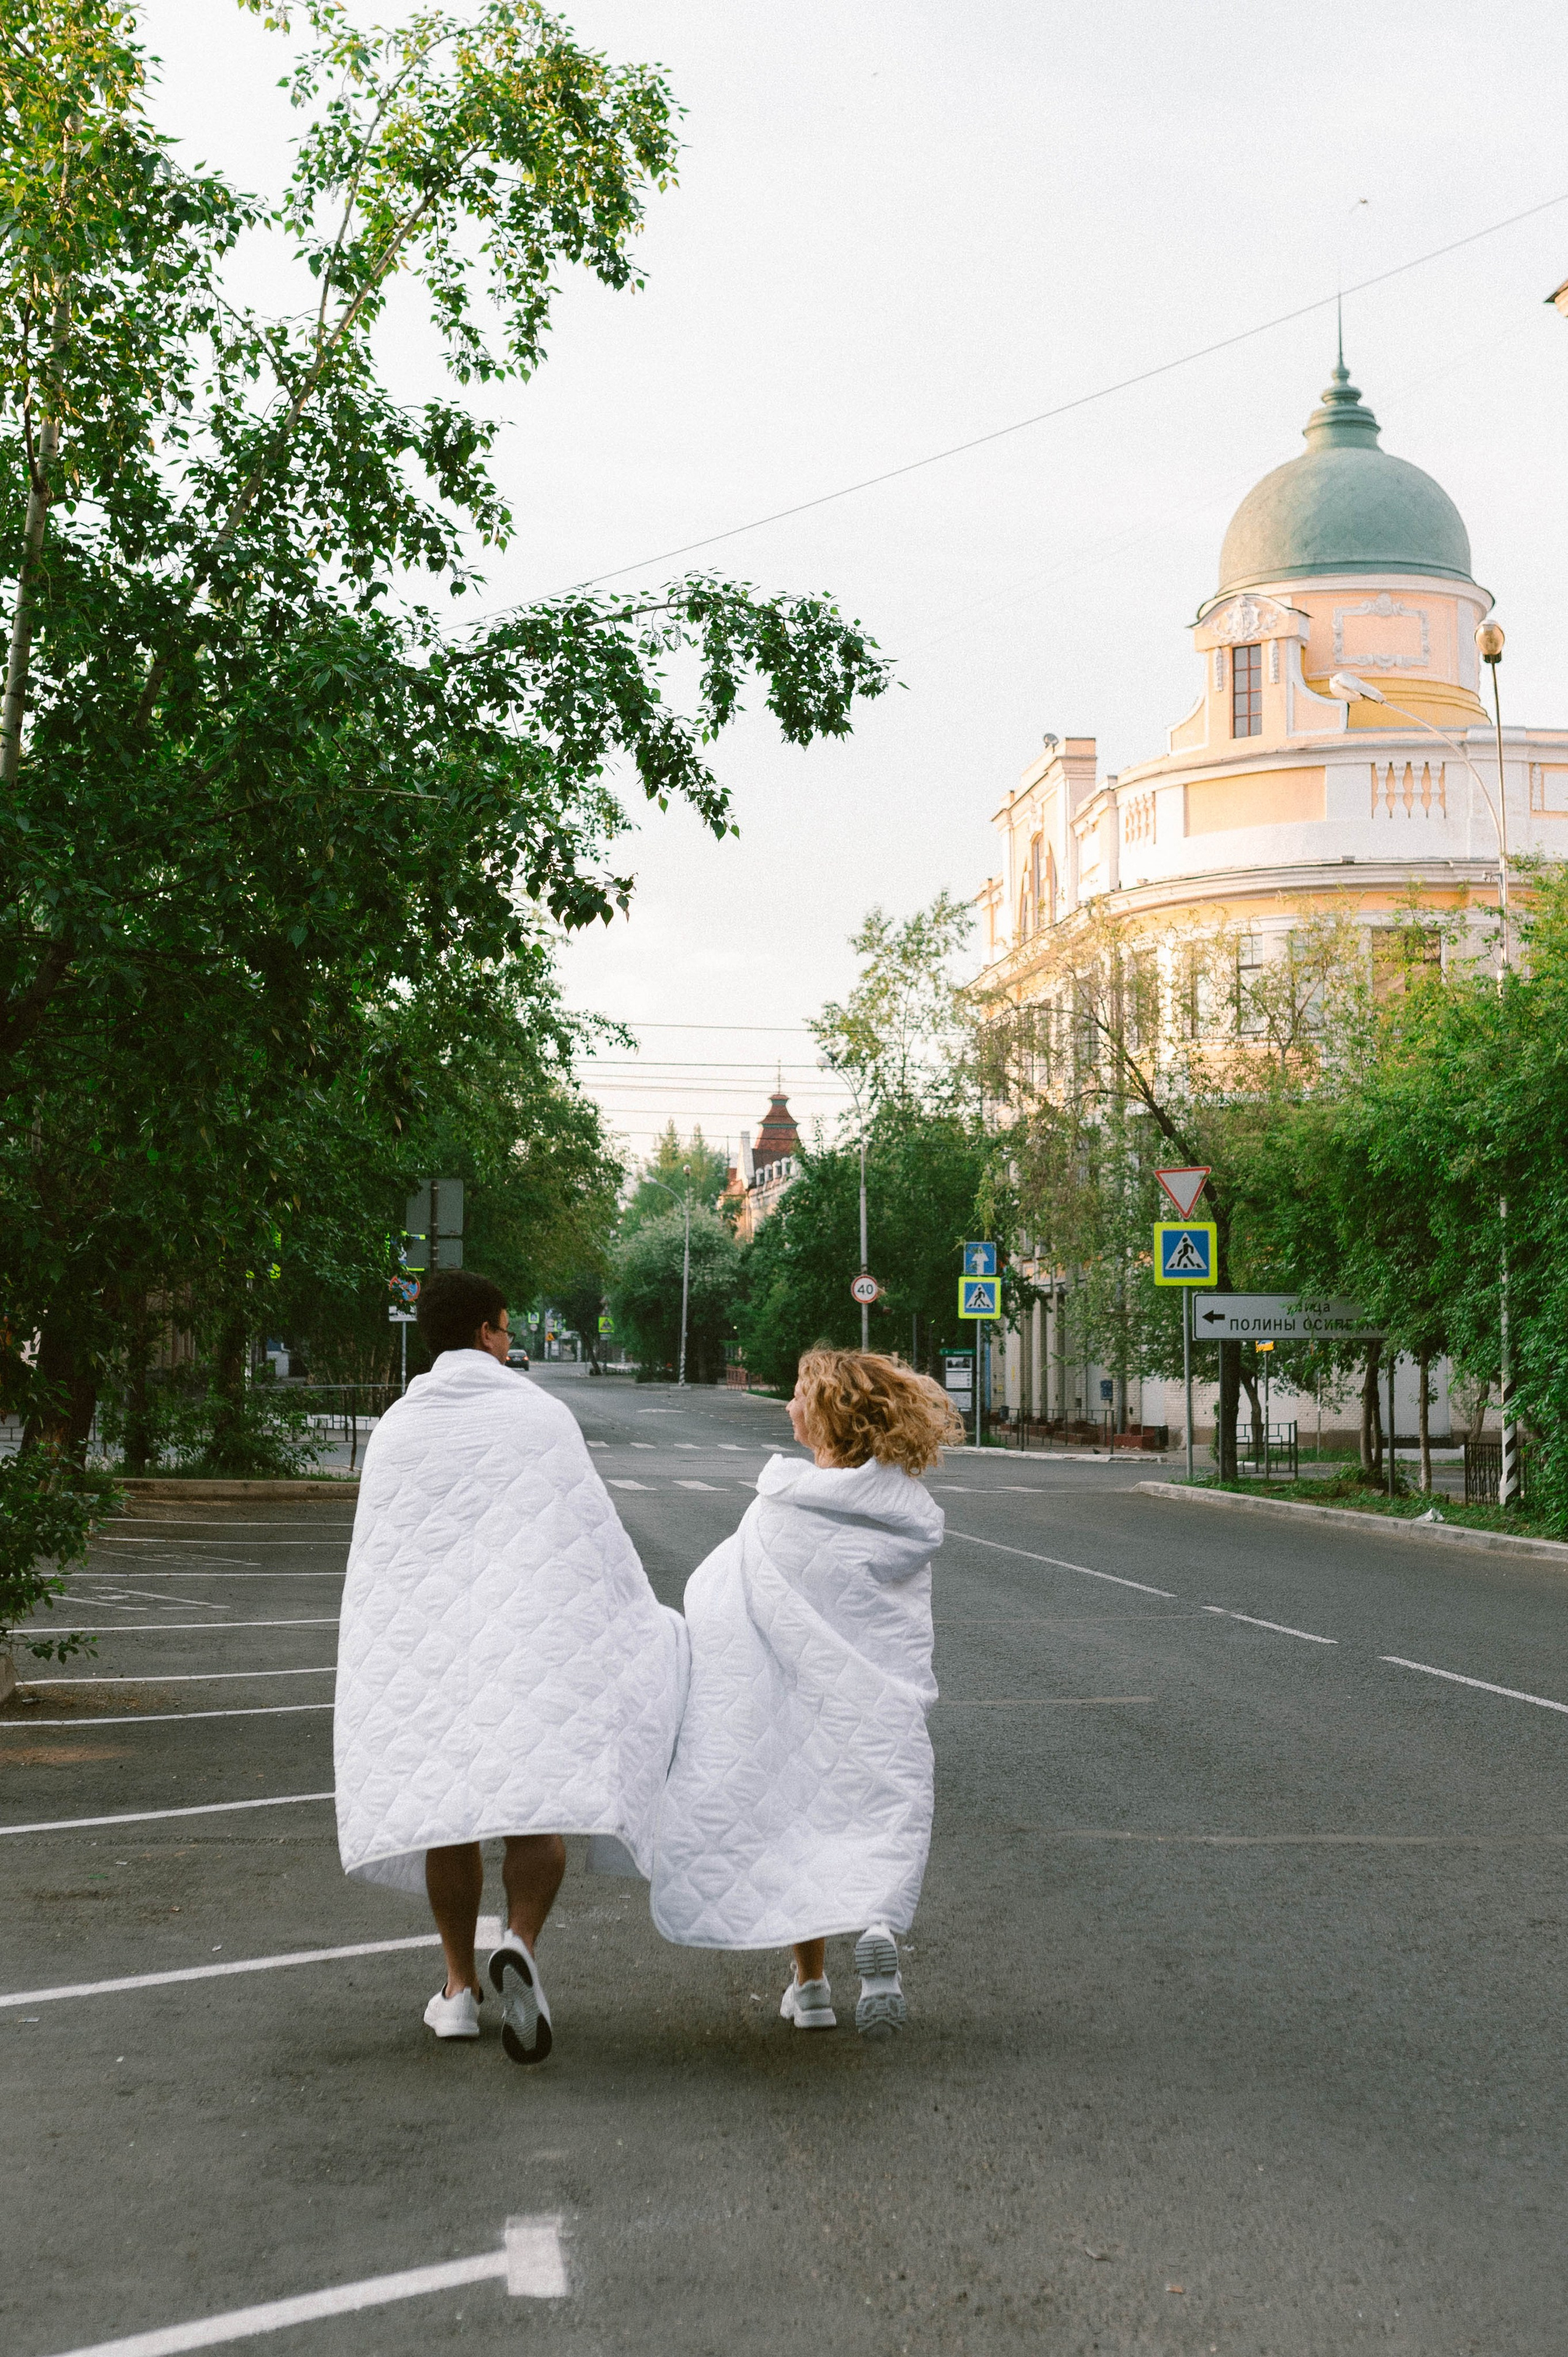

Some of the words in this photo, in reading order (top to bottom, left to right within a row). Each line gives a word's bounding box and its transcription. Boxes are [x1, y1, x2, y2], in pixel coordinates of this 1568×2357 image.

[857, 1284, 873, 1295] 40
[1230, 1319, 1295, 1331] ПОЛИНЫ
[1303, 1319, 1386, 1331] ОСИПЕ
